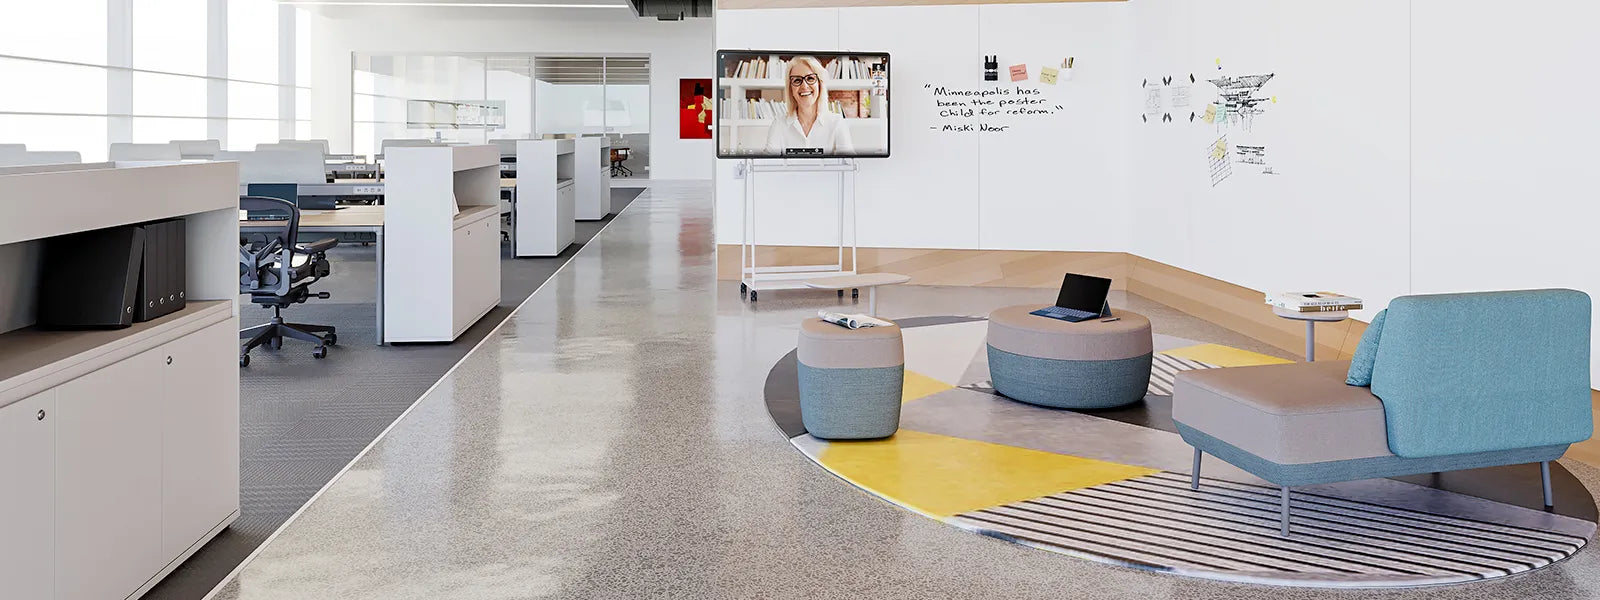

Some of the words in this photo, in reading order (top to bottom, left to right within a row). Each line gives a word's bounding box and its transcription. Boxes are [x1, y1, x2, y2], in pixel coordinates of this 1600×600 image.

[1016, 86, 1040, 95] has
[937, 99, 967, 107] been
[999, 98, 1047, 107] poster
[979, 108, 1000, 116] for
[942, 124, 973, 132] Miski
[979, 124, 1010, 132] Noor
